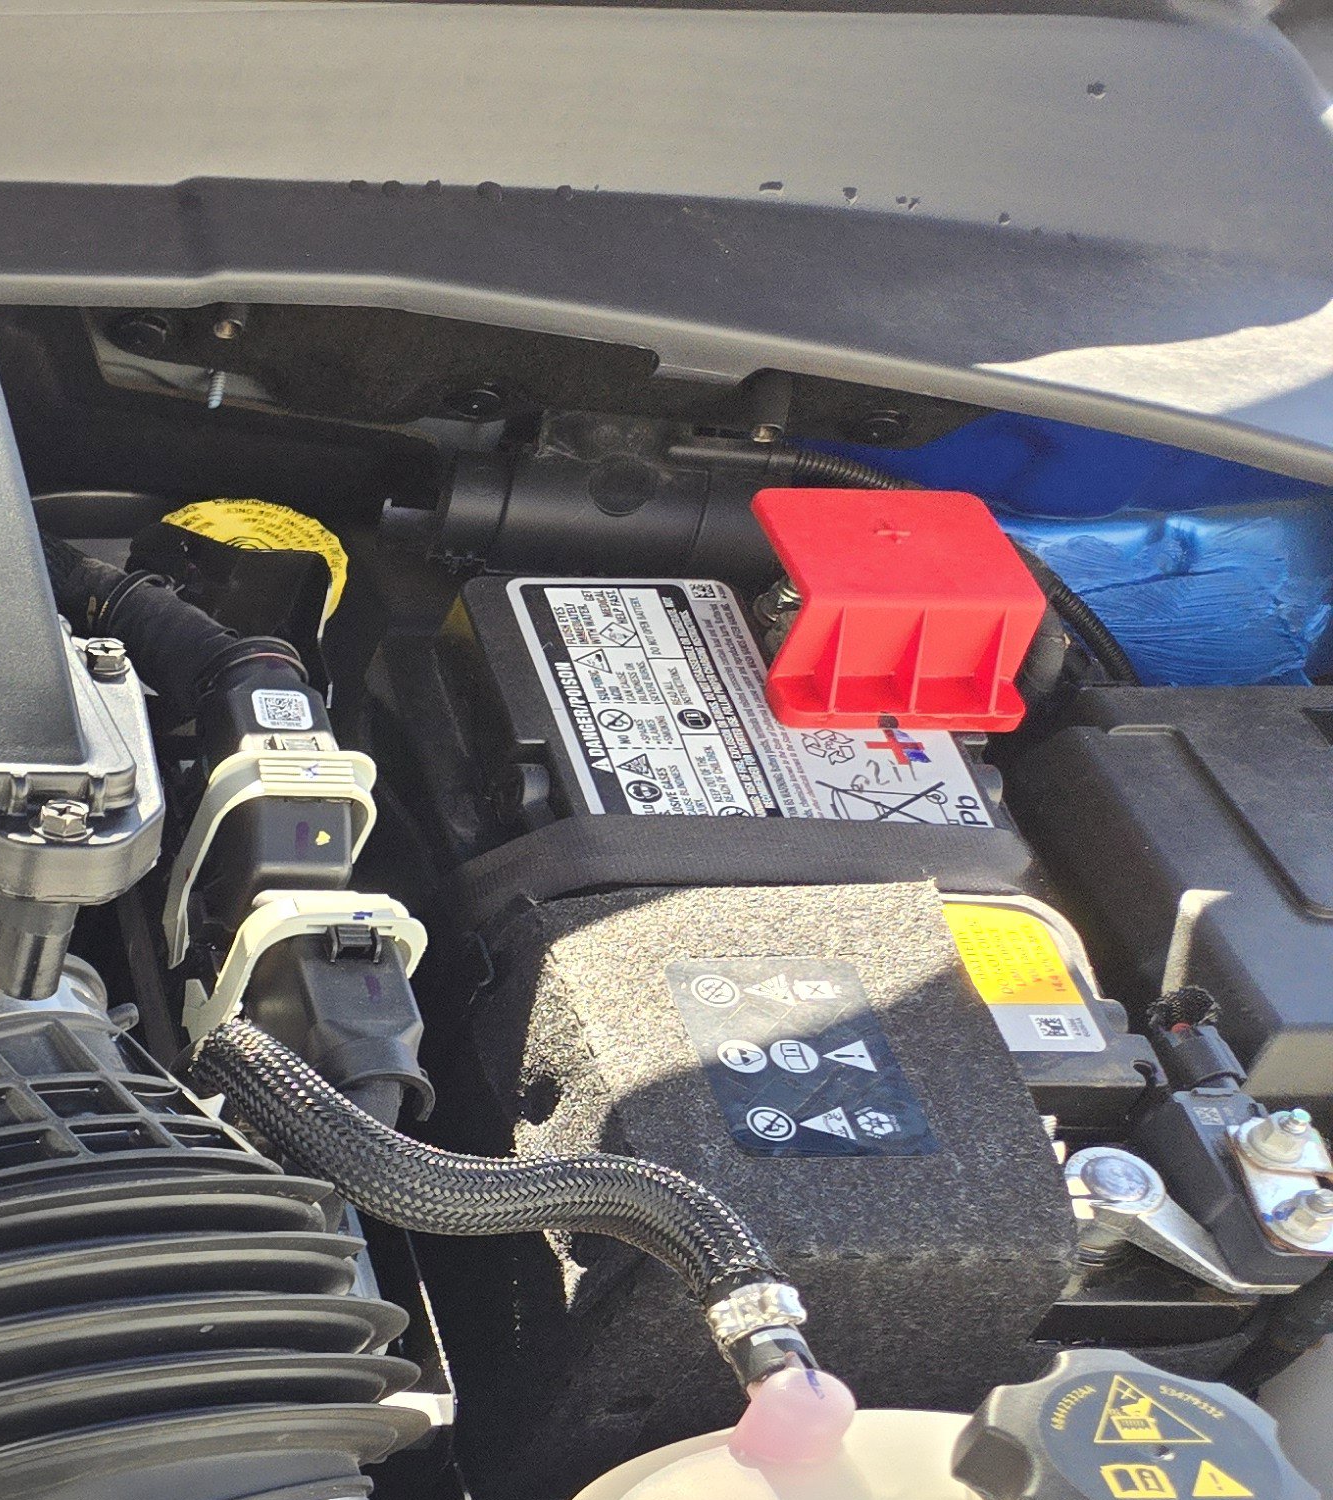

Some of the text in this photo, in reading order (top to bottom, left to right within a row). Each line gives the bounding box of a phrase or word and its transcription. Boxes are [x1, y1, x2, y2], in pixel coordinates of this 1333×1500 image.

[593, 589, 613, 617] MEDICAL
[553, 661, 606, 756] DANGER/POISON
[954, 795, 988, 826] Pb
